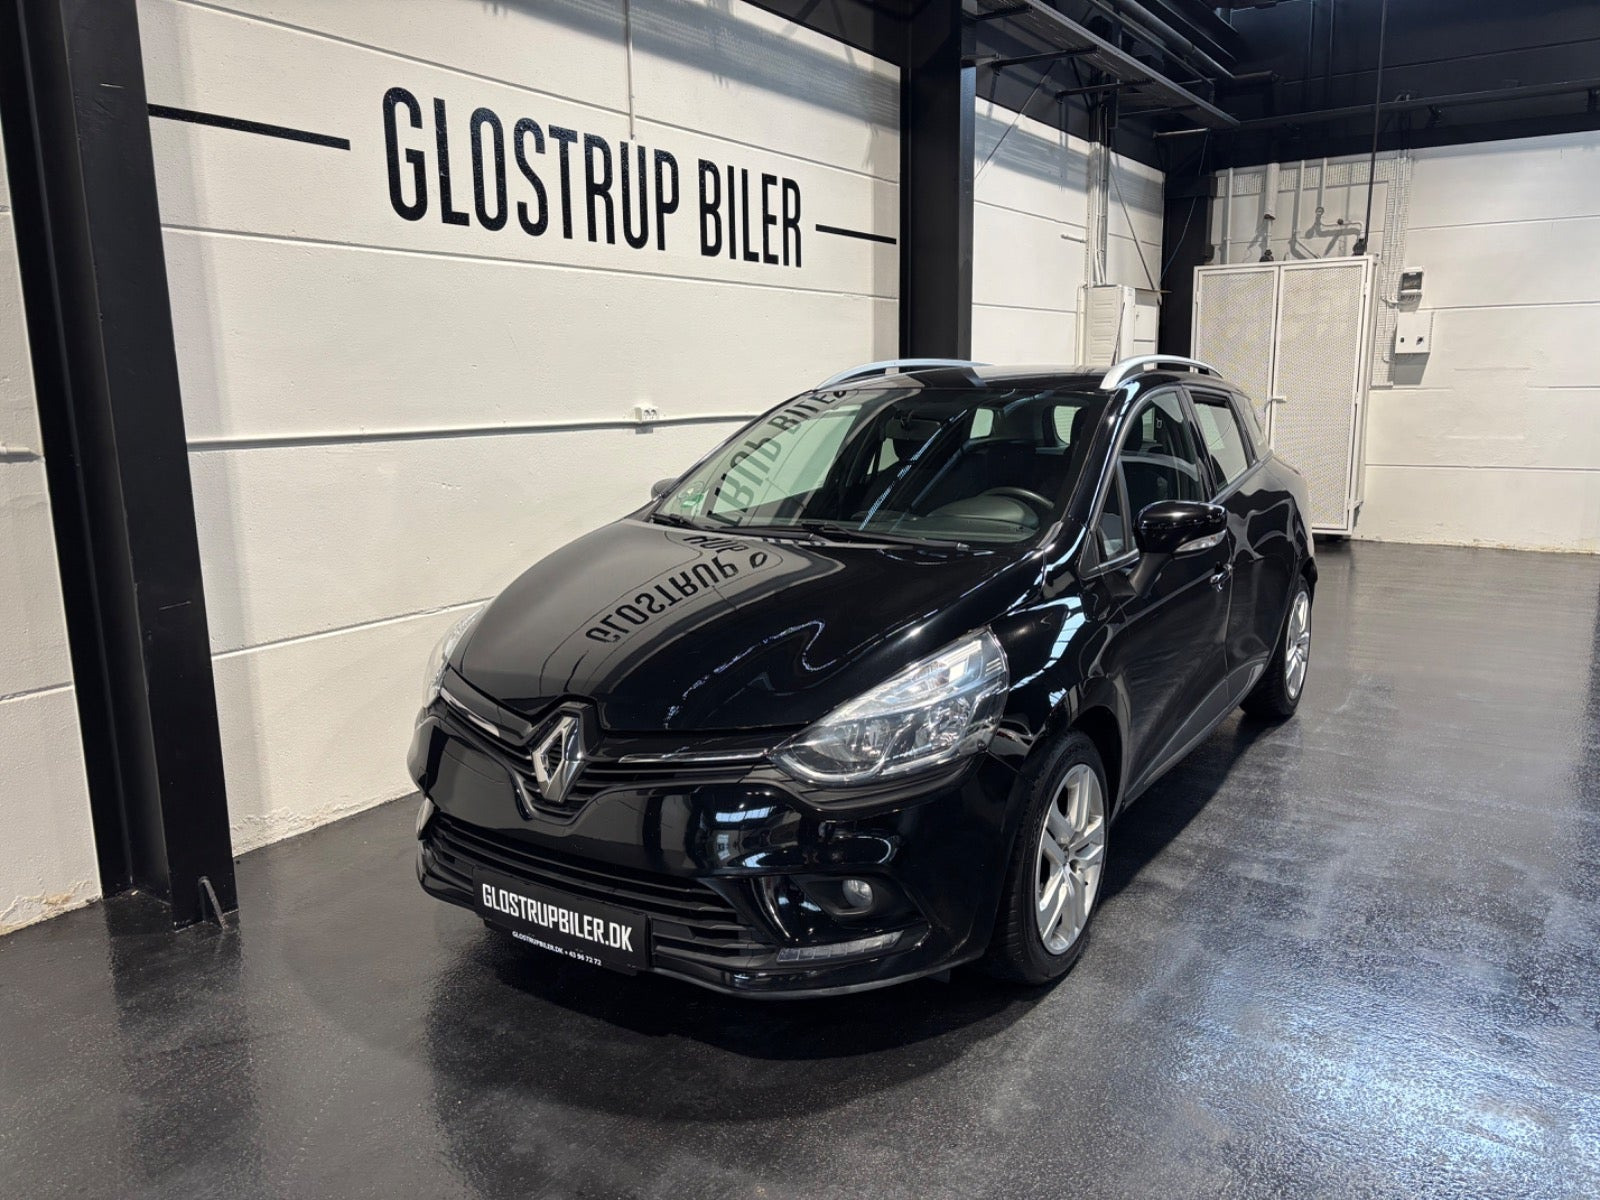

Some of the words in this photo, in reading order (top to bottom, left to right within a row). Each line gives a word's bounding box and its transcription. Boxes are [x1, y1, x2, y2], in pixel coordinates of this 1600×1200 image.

[382, 86, 680, 252] GLOSTRUP
[698, 158, 802, 268] BILER
[482, 883, 633, 952] GLOSTRUPBILER.DK
[511, 930, 564, 955] GLOSTRUPBILER.DK
